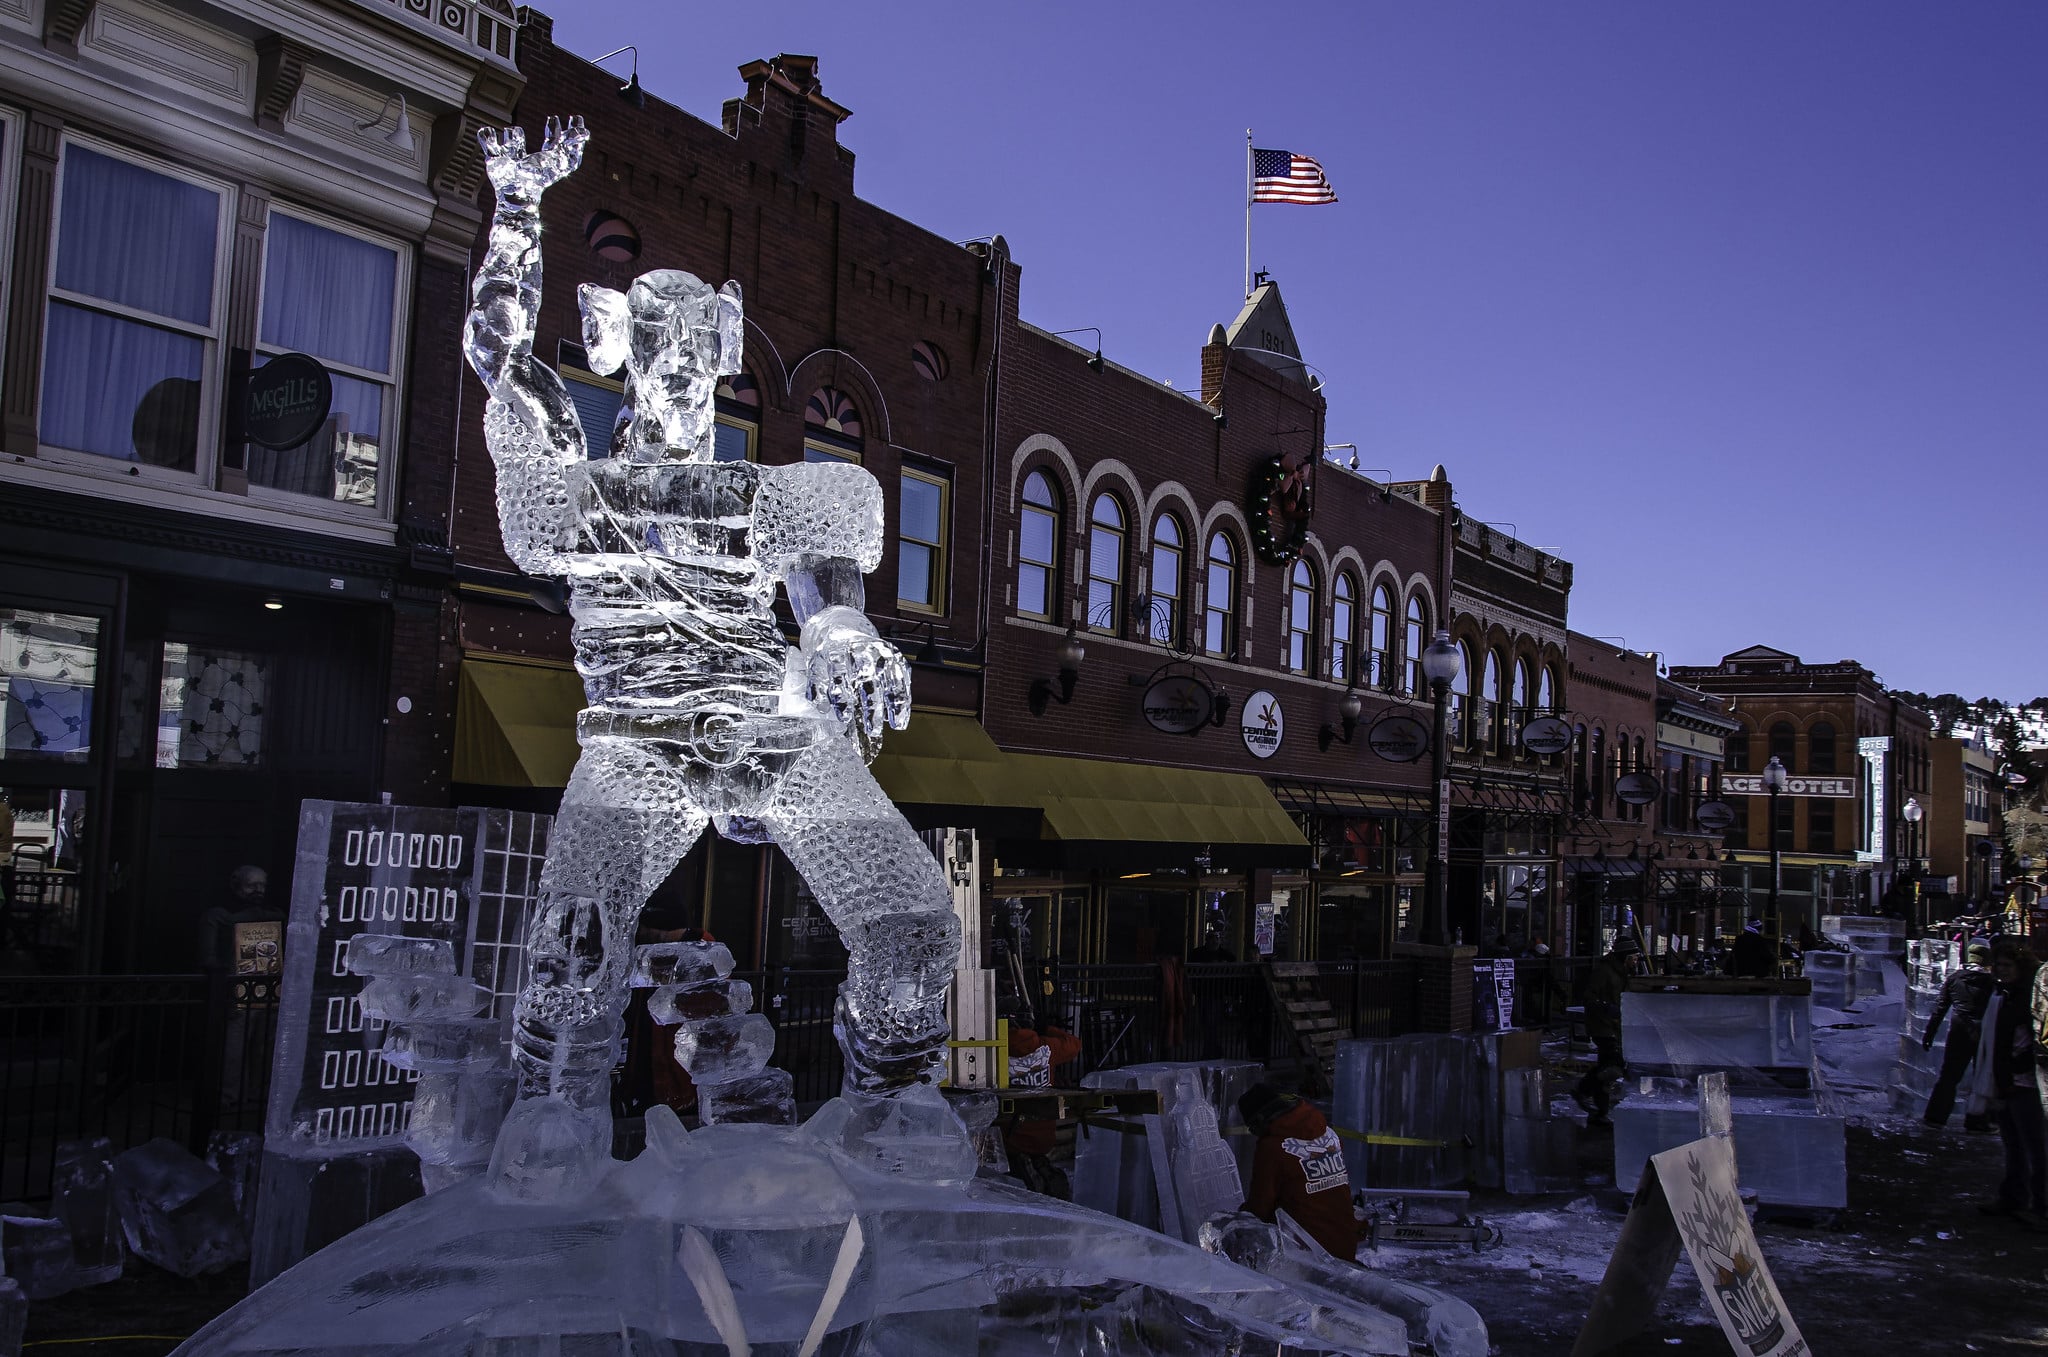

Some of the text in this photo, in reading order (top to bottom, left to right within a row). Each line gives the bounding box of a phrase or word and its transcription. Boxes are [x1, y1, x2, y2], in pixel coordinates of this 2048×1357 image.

[1243, 727, 1278, 737] CENTURY
[1248, 735, 1277, 745] CASINO
[781, 917, 830, 928] CENTU
[1011, 1069, 1048, 1087] SNICE
[1721, 1268, 1777, 1338] SNICE
